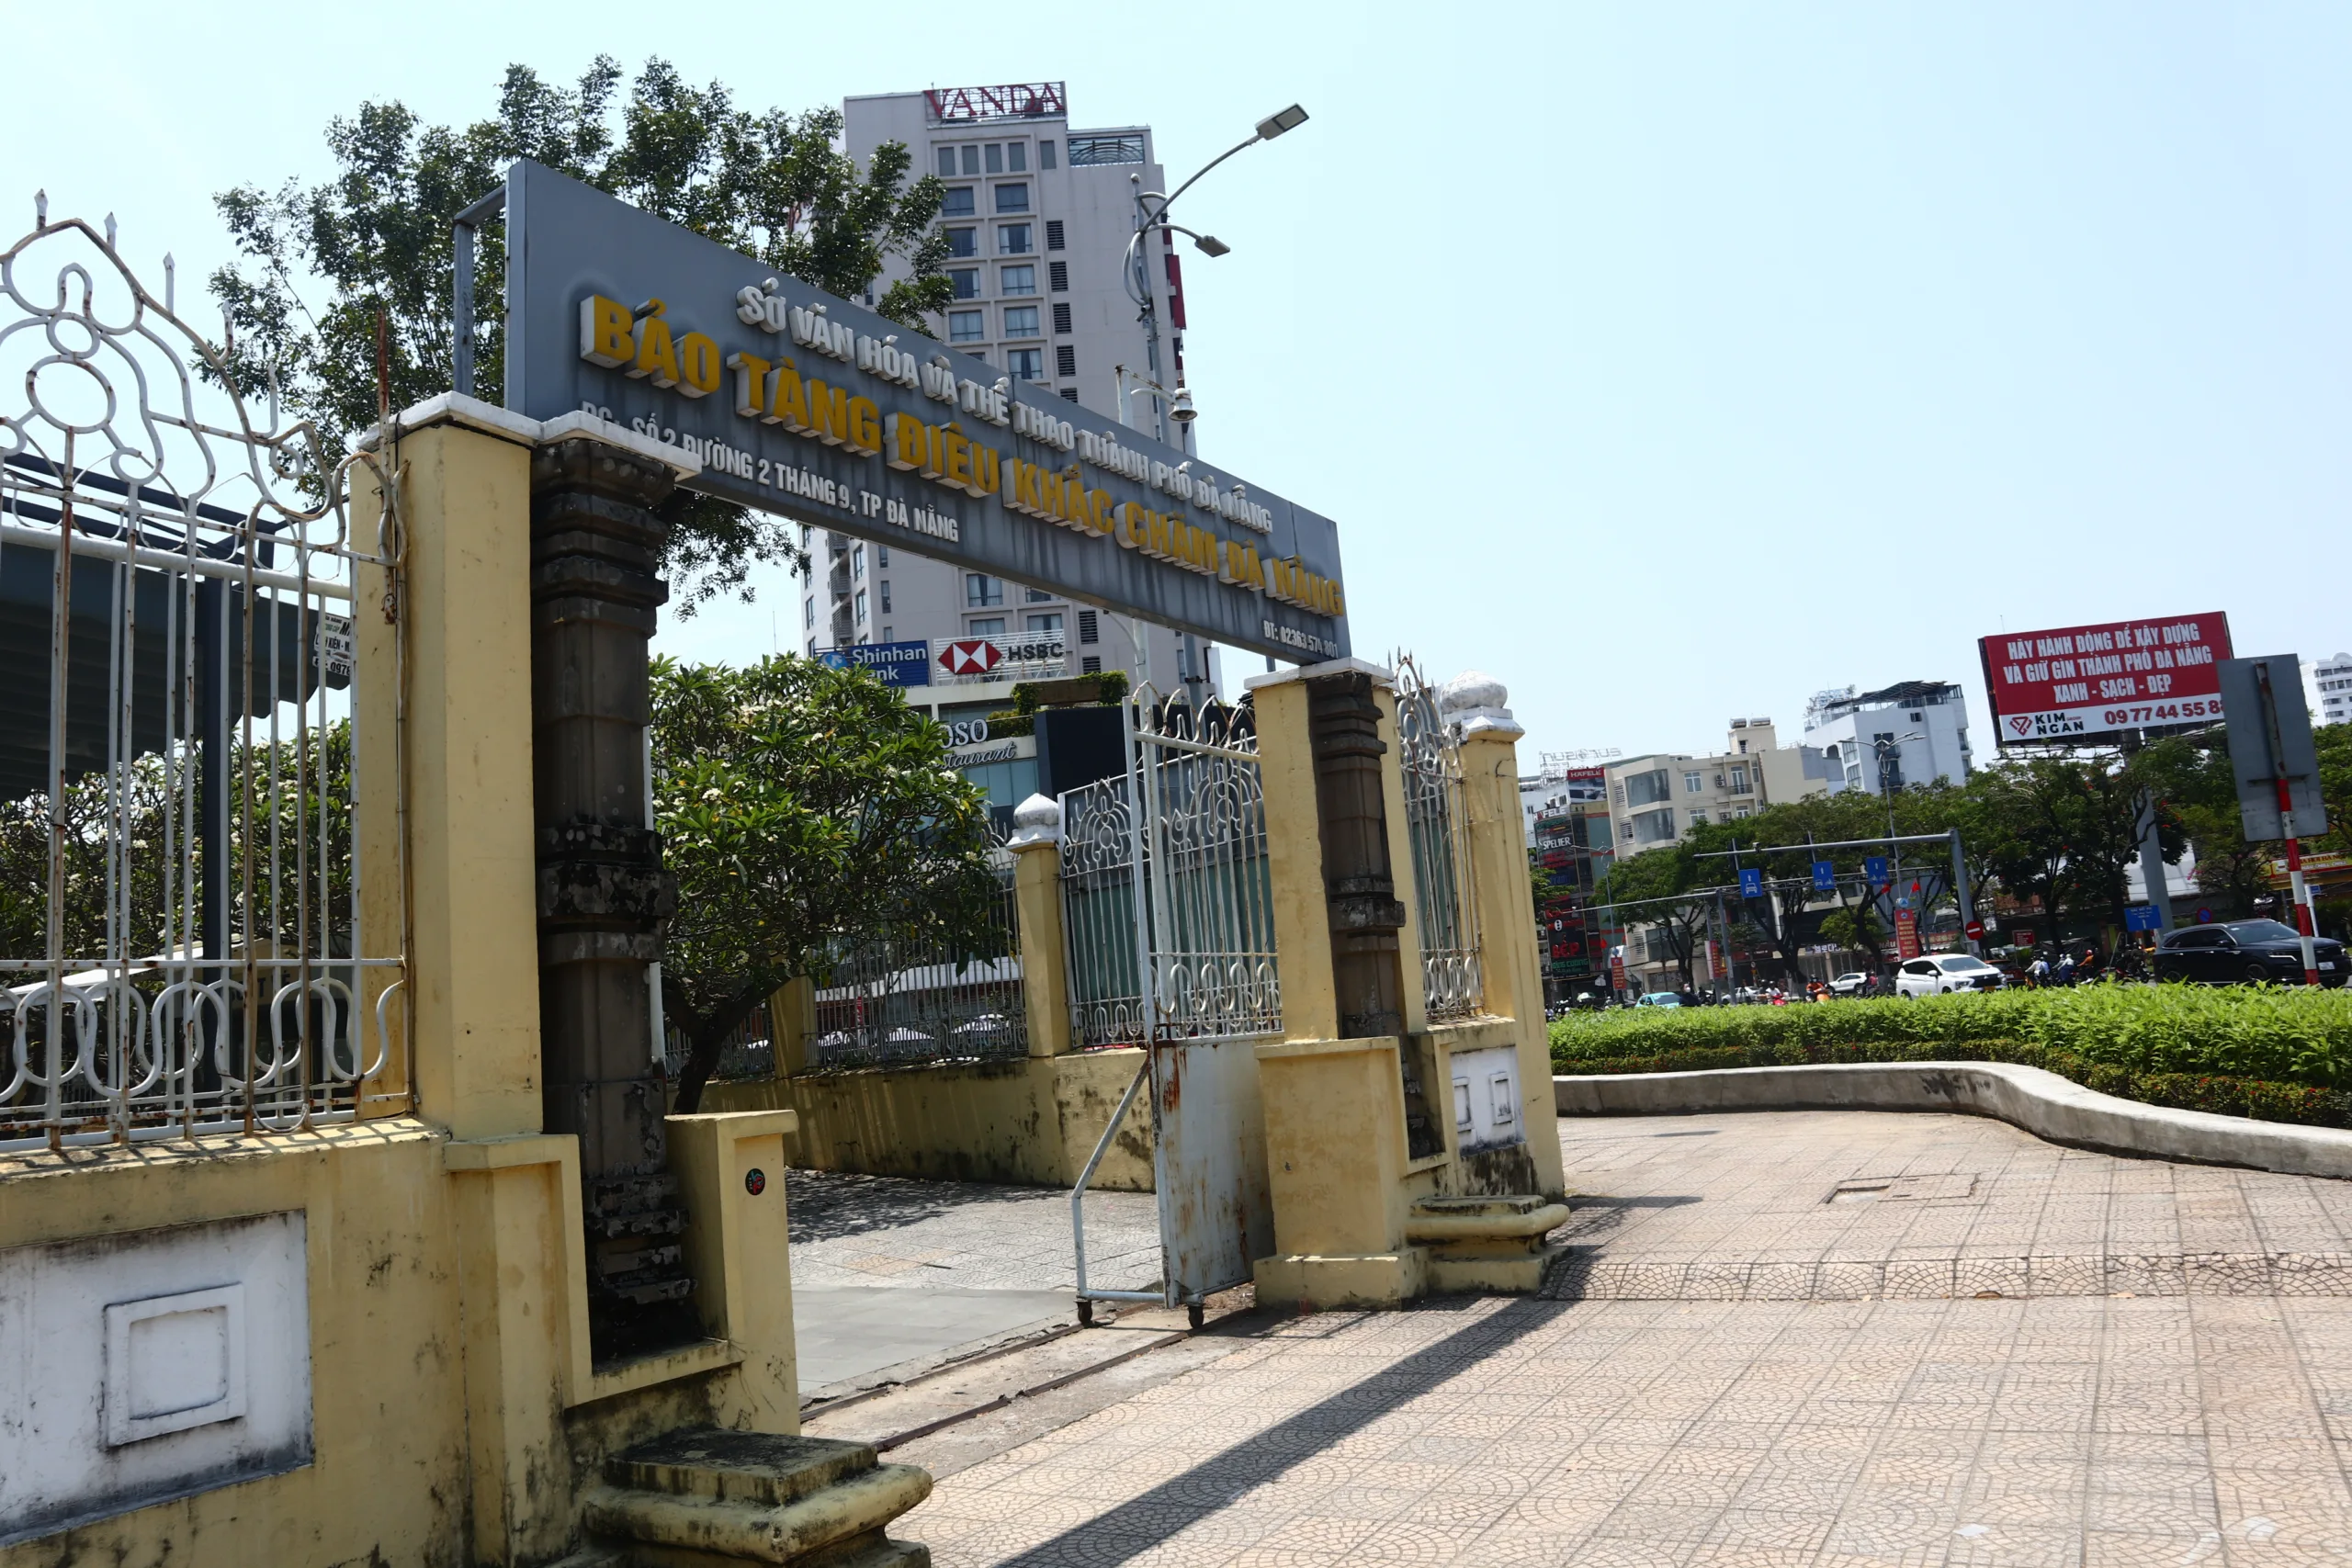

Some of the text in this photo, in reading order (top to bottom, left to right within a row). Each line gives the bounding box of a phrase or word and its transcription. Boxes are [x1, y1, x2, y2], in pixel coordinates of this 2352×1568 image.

[922, 82, 1065, 118] VANDA
[737, 277, 1273, 535] SỞ VĂN HÓA VÀ THỂ THAO THÀNH PHỐ ĐÀ NẴNG
[581, 294, 720, 398] BẢO
[726, 352, 881, 457] TÀNG
[884, 412, 1000, 498] ĐIÊU
[1001, 457, 1114, 537] KHẮC
[1114, 502, 1219, 576] CHĂM
[1218, 539, 1265, 592] ĐÀ
[683, 433, 753, 480] ĐƯỜNG
[757, 458, 770, 485] 2
[775, 462, 836, 505] THÁNG
[838, 485, 856, 514] 9,
[859, 490, 882, 518] TP
[886, 497, 910, 528] ĐÀ
[912, 503, 959, 543] NẴNG
[1280, 626, 1307, 649] 02363
[2007, 622, 2200, 660] HÃY HÀNH ĐỘNG ĐỂ XÂY DỰNG
[852, 646, 926, 664] Shinhan
[1008, 642, 1063, 660] HSBC
[2003, 642, 2212, 683] VÀ GIỮ GÌN THÀNH PHỐ ĐÀ NẴNG
[866, 665, 899, 681] ank
[2053, 682, 2088, 703] XANH
[2099, 678, 2136, 701] SẠCH
[2146, 674, 2171, 696] ĐẸP
[2035, 712, 2065, 725] KIM
[2105, 709, 2128, 726] 09
[2130, 706, 2152, 722] 77
[2155, 705, 2178, 719] 44
[2182, 702, 2205, 717] 55
[2037, 721, 2084, 735] NGAN
